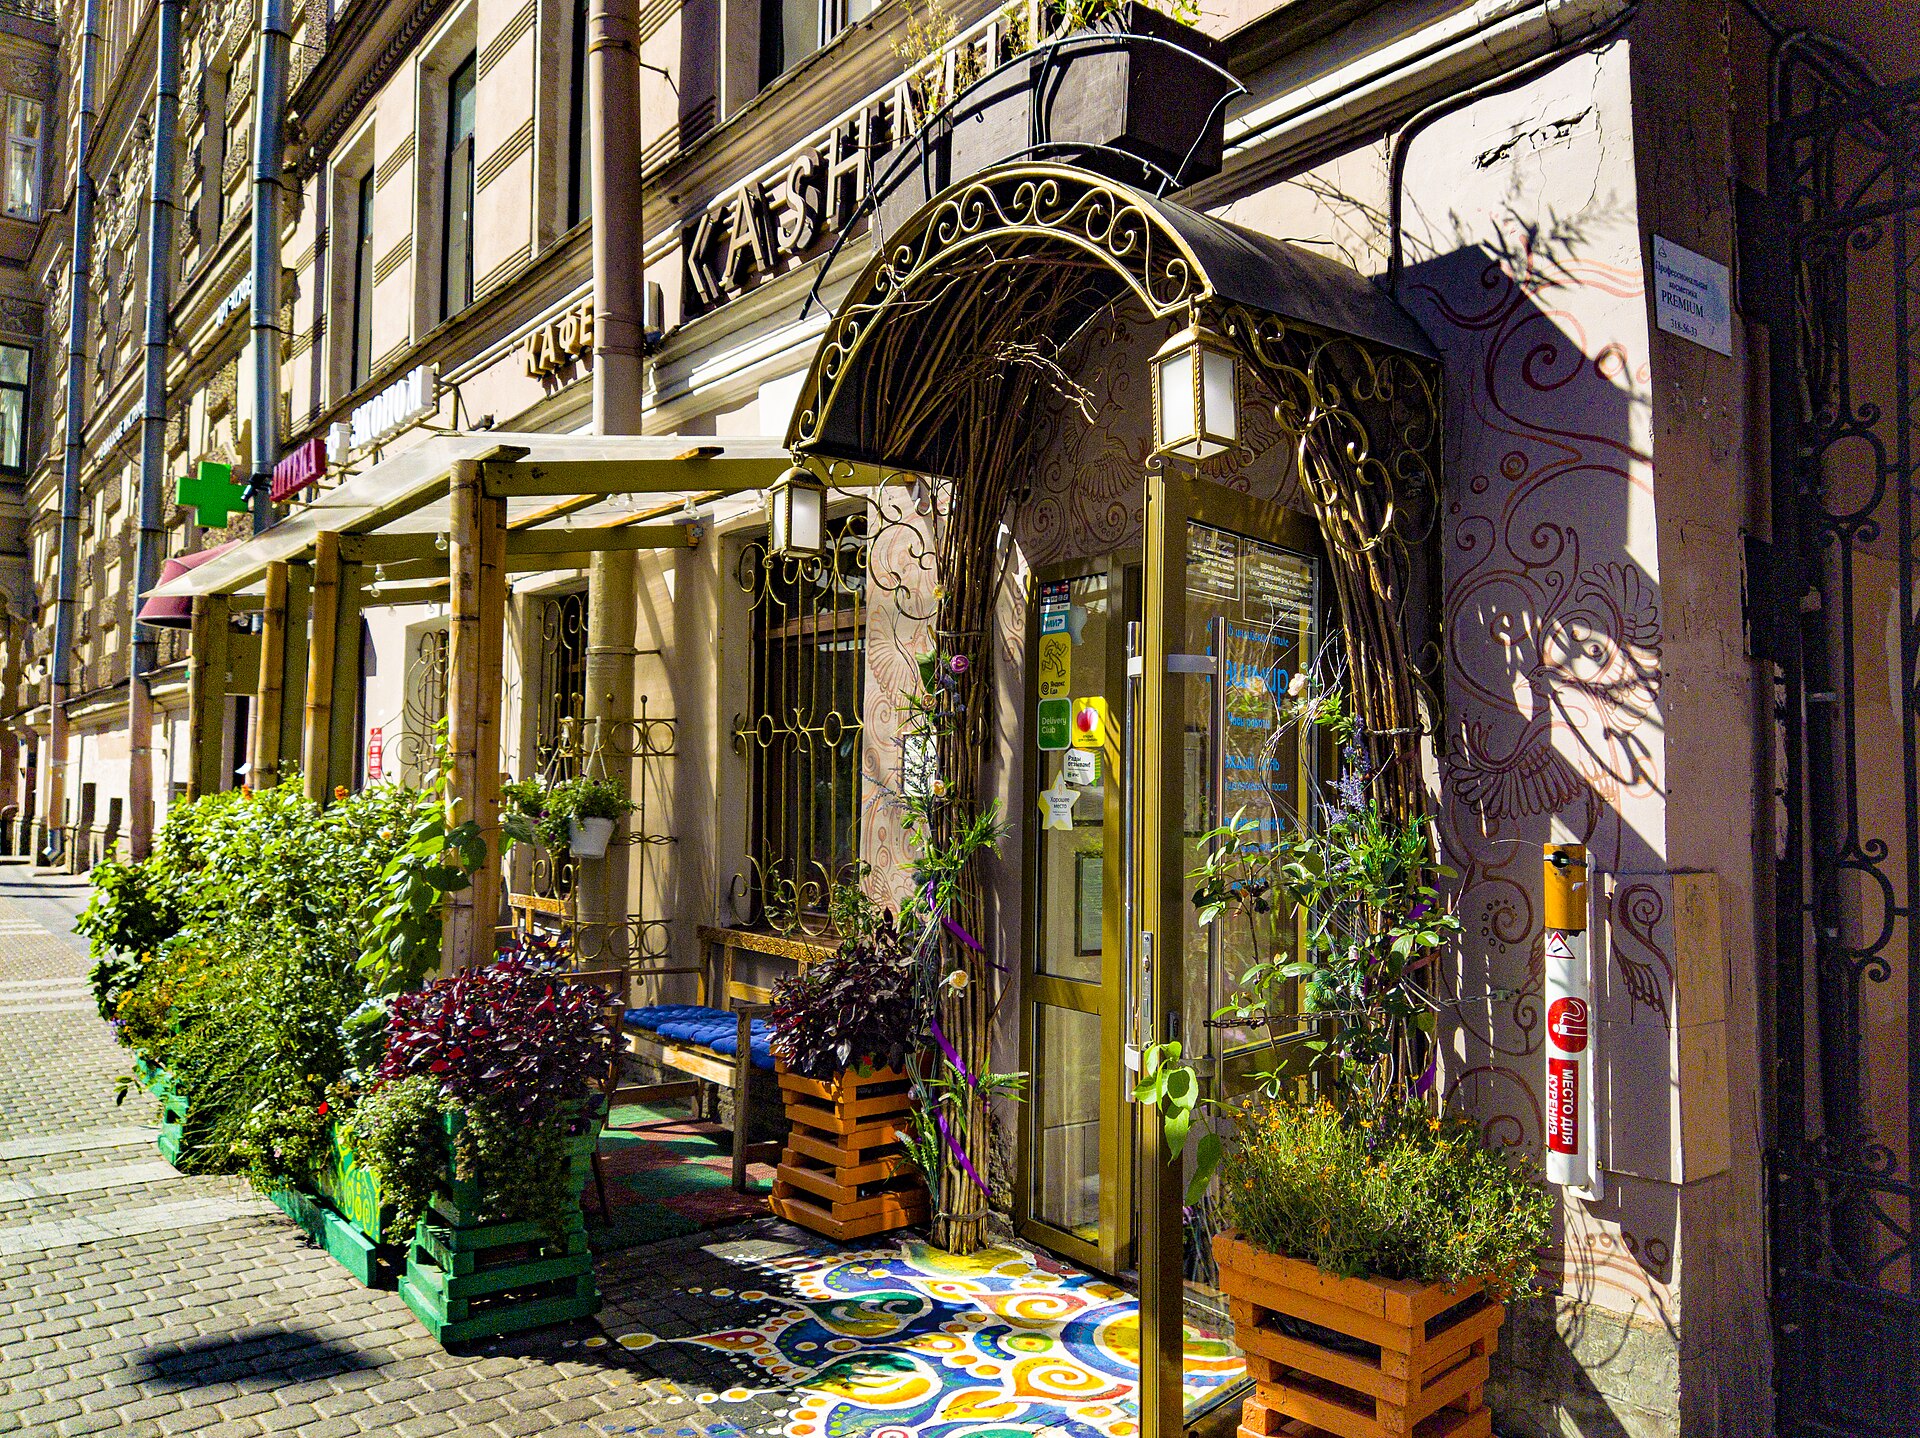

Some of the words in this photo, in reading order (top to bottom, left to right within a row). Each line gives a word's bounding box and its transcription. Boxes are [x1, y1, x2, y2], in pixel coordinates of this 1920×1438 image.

[686, 0, 1070, 305] KASHMI
[1661, 289, 1705, 318] PREMIUM
[523, 296, 594, 380] КАФЕ
[350, 364, 430, 449] ЭКОНОМ
[1041, 716, 1067, 726] Delivery
[1041, 726, 1056, 734] Club
[1548, 1074, 1559, 1136] КУРЕНИЯ
[1562, 1068, 1574, 1115] МЕСТО
[1560, 1116, 1573, 1145] ДЛЯ
